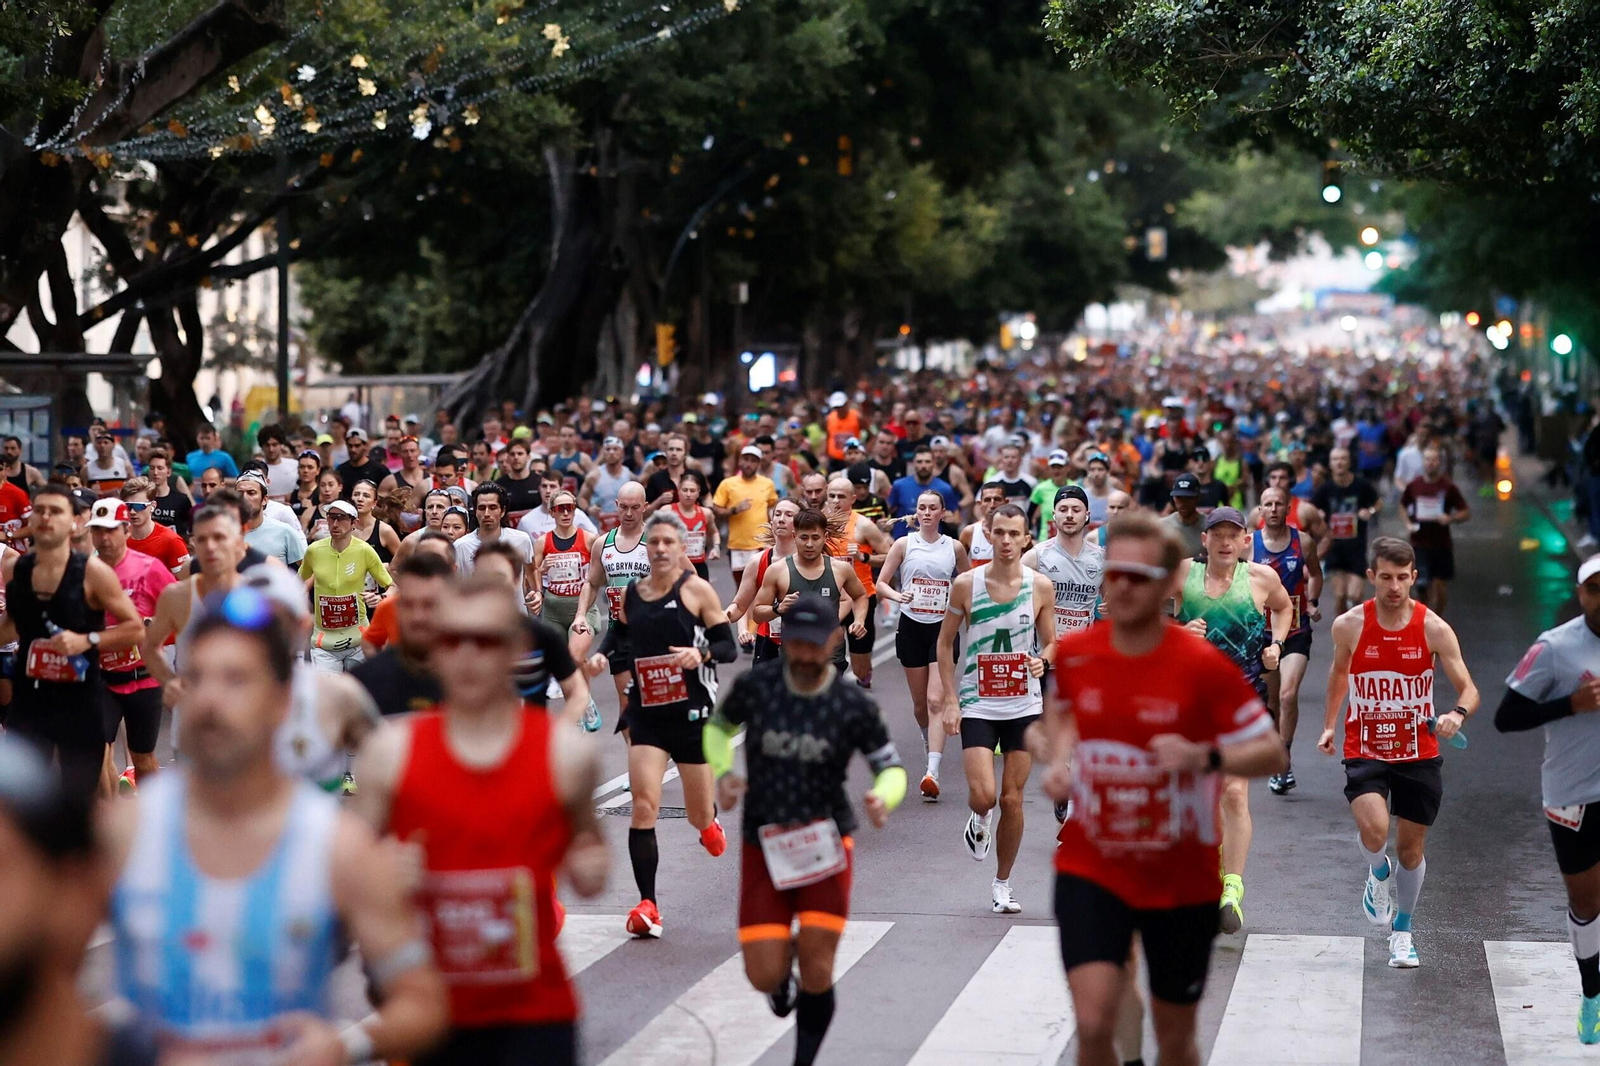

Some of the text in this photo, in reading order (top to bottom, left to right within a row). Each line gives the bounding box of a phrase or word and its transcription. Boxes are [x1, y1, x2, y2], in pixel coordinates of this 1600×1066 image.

[616, 561, 633, 571] BRYN
[918, 586, 941, 596] 14870
[1065, 591, 1089, 602] BETTER
[328, 604, 347, 612] 1753
[1057, 617, 1083, 627] 15587
[990, 653, 1021, 662] GENERALI
[647, 667, 672, 680] 3416
[992, 664, 1010, 673] 551
[1374, 711, 1407, 720] GENERALI
[1376, 723, 1396, 733] 350
